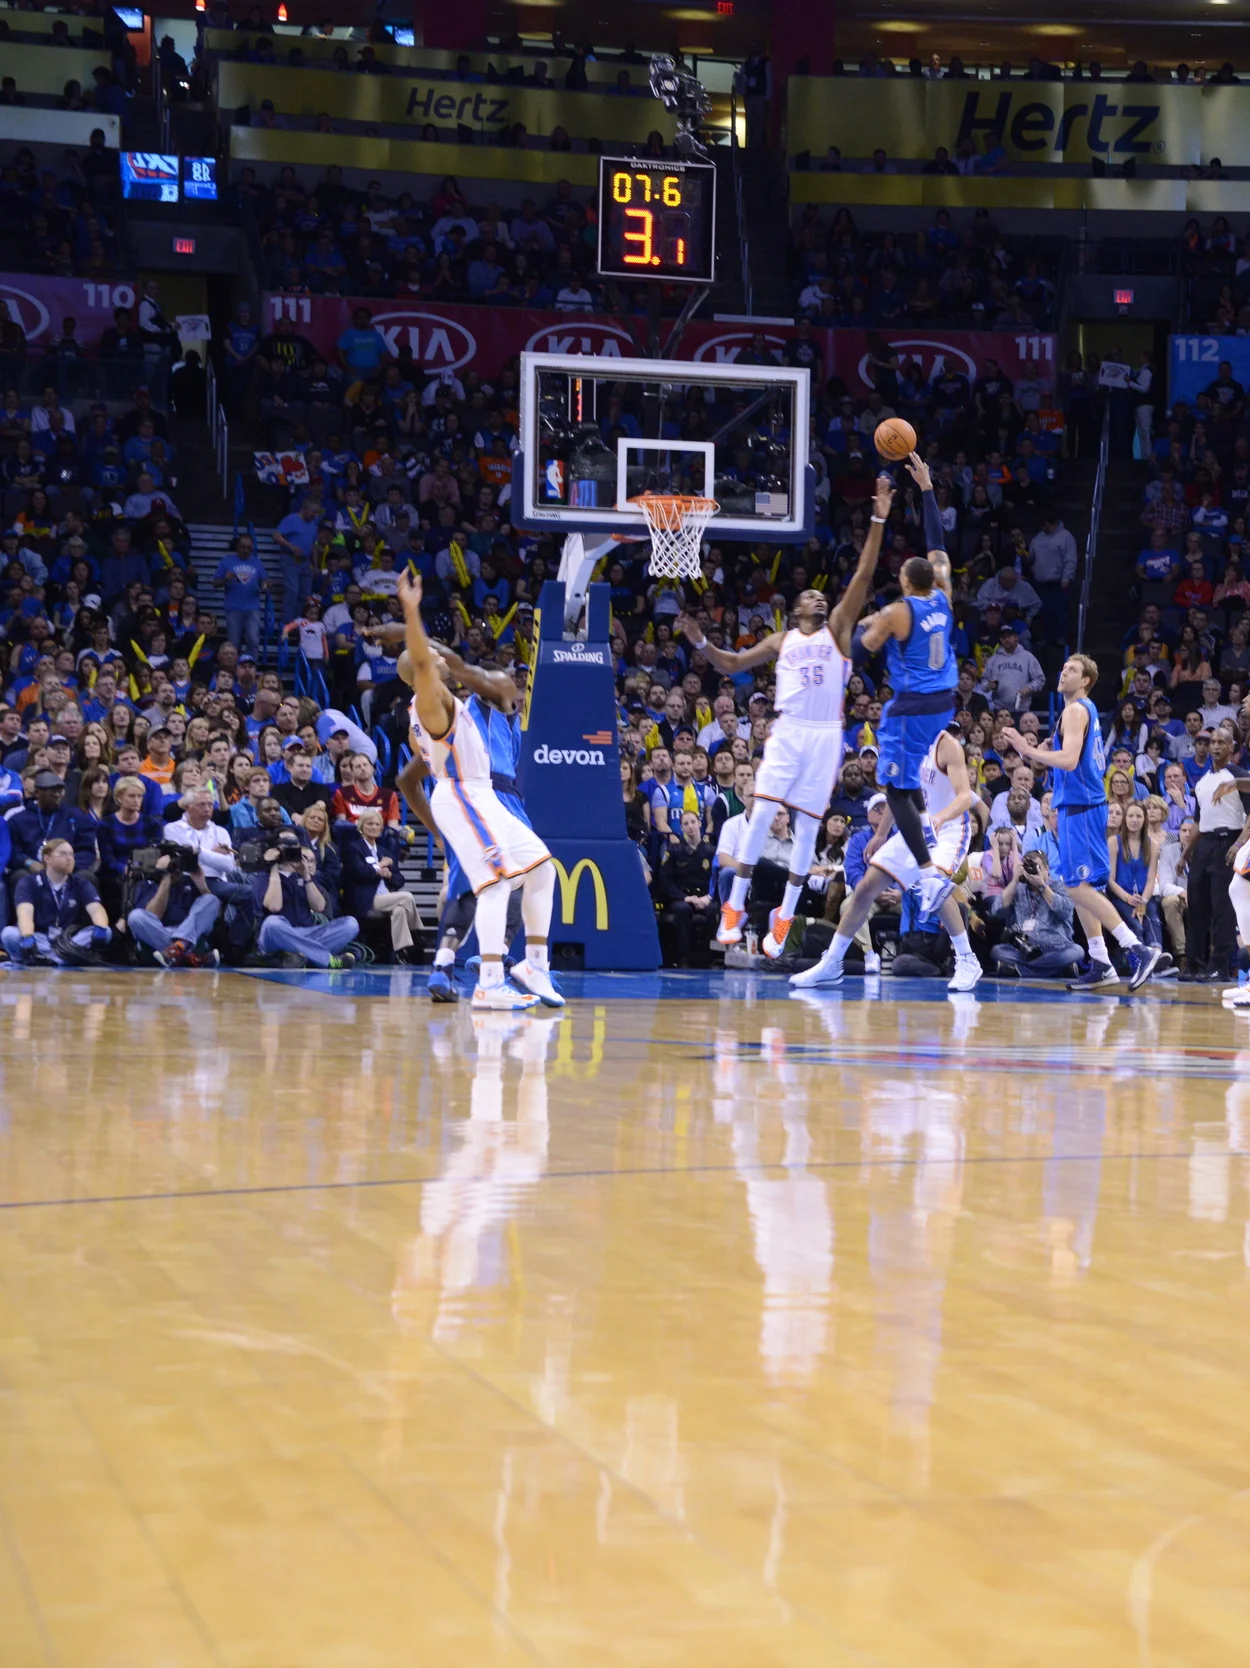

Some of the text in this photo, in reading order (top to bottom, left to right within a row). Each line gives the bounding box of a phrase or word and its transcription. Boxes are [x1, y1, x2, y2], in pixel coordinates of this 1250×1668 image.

[717, 2, 734, 15] EXIT
[406, 87, 510, 122] Hertz
[955, 91, 1161, 154] Hertz
[630, 162, 686, 172] DAKTRONICS
[613, 172, 682, 207] 07.6
[83, 283, 136, 309] 110
[270, 297, 312, 323] 111
[374, 324, 455, 362] KIA
[1015, 336, 1052, 361] 111
[1175, 339, 1219, 362] 112
[553, 649, 604, 665] SPALDING
[800, 665, 824, 687] 35
[534, 744, 605, 766] devon
